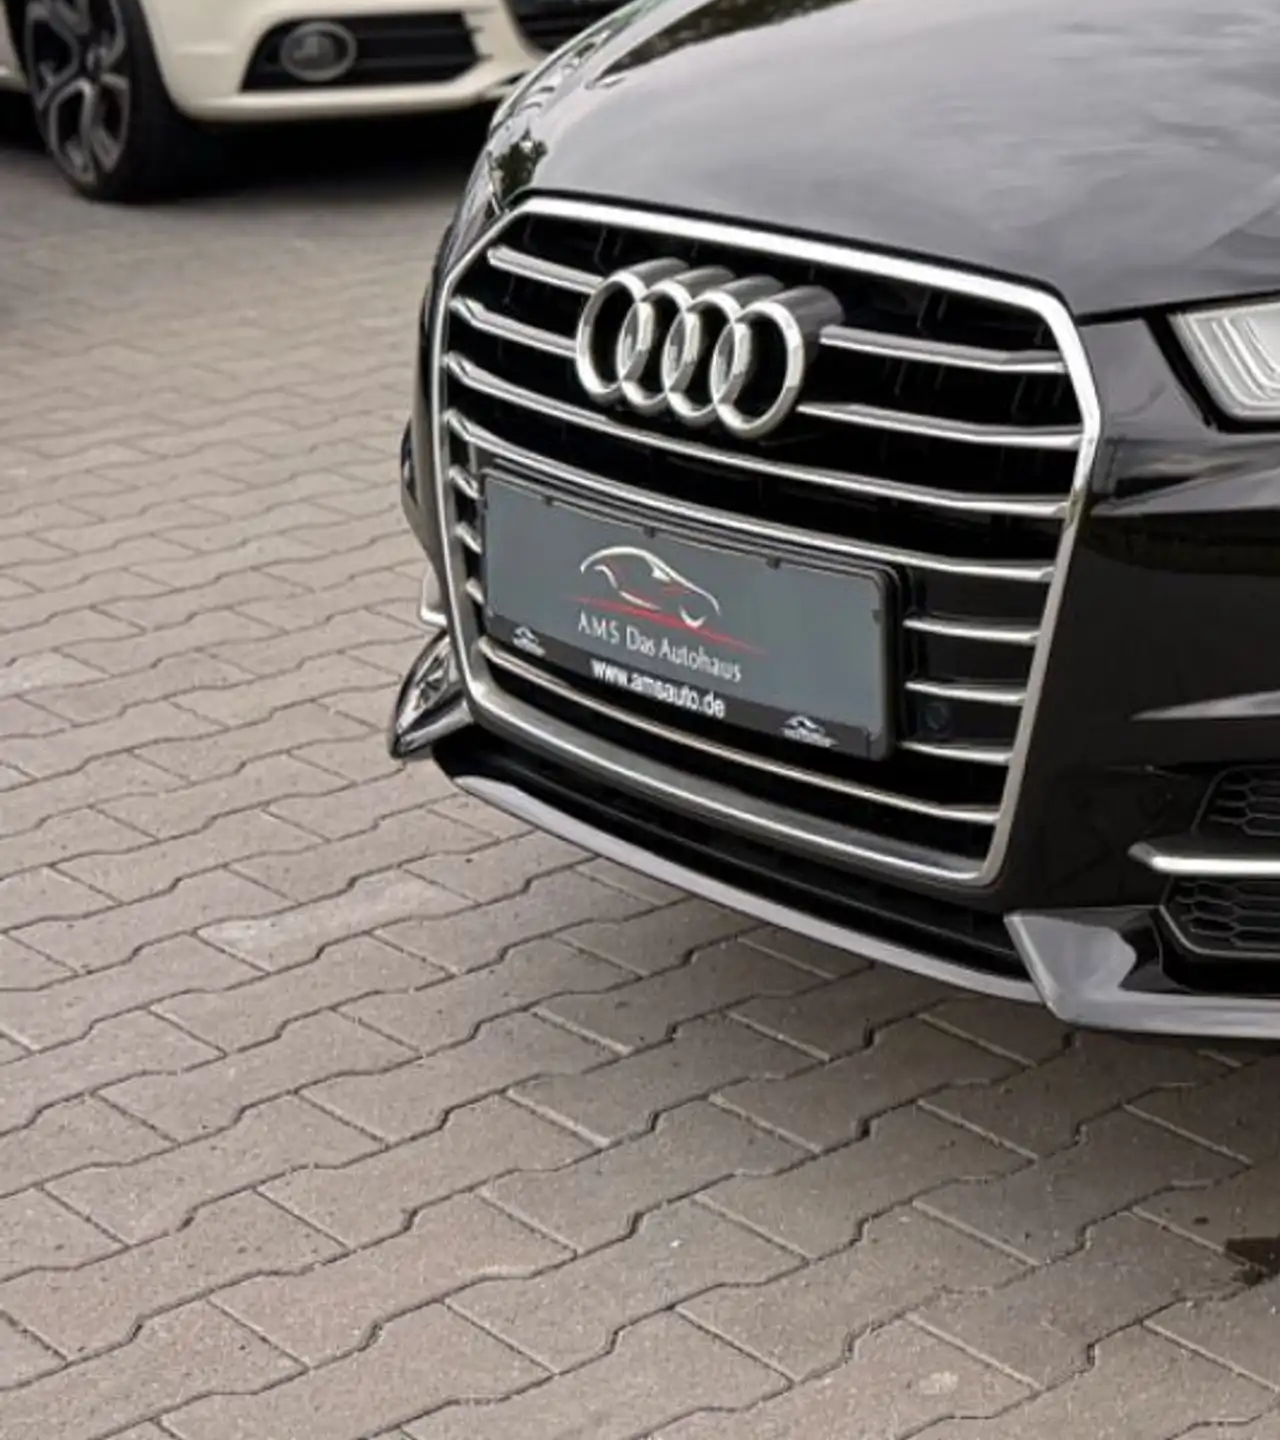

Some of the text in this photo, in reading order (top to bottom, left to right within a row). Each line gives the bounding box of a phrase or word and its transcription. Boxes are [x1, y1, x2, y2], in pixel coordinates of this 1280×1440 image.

[578, 611, 742, 683] AMS Das Autohaus
[591, 659, 726, 719] www.amsauto.de
